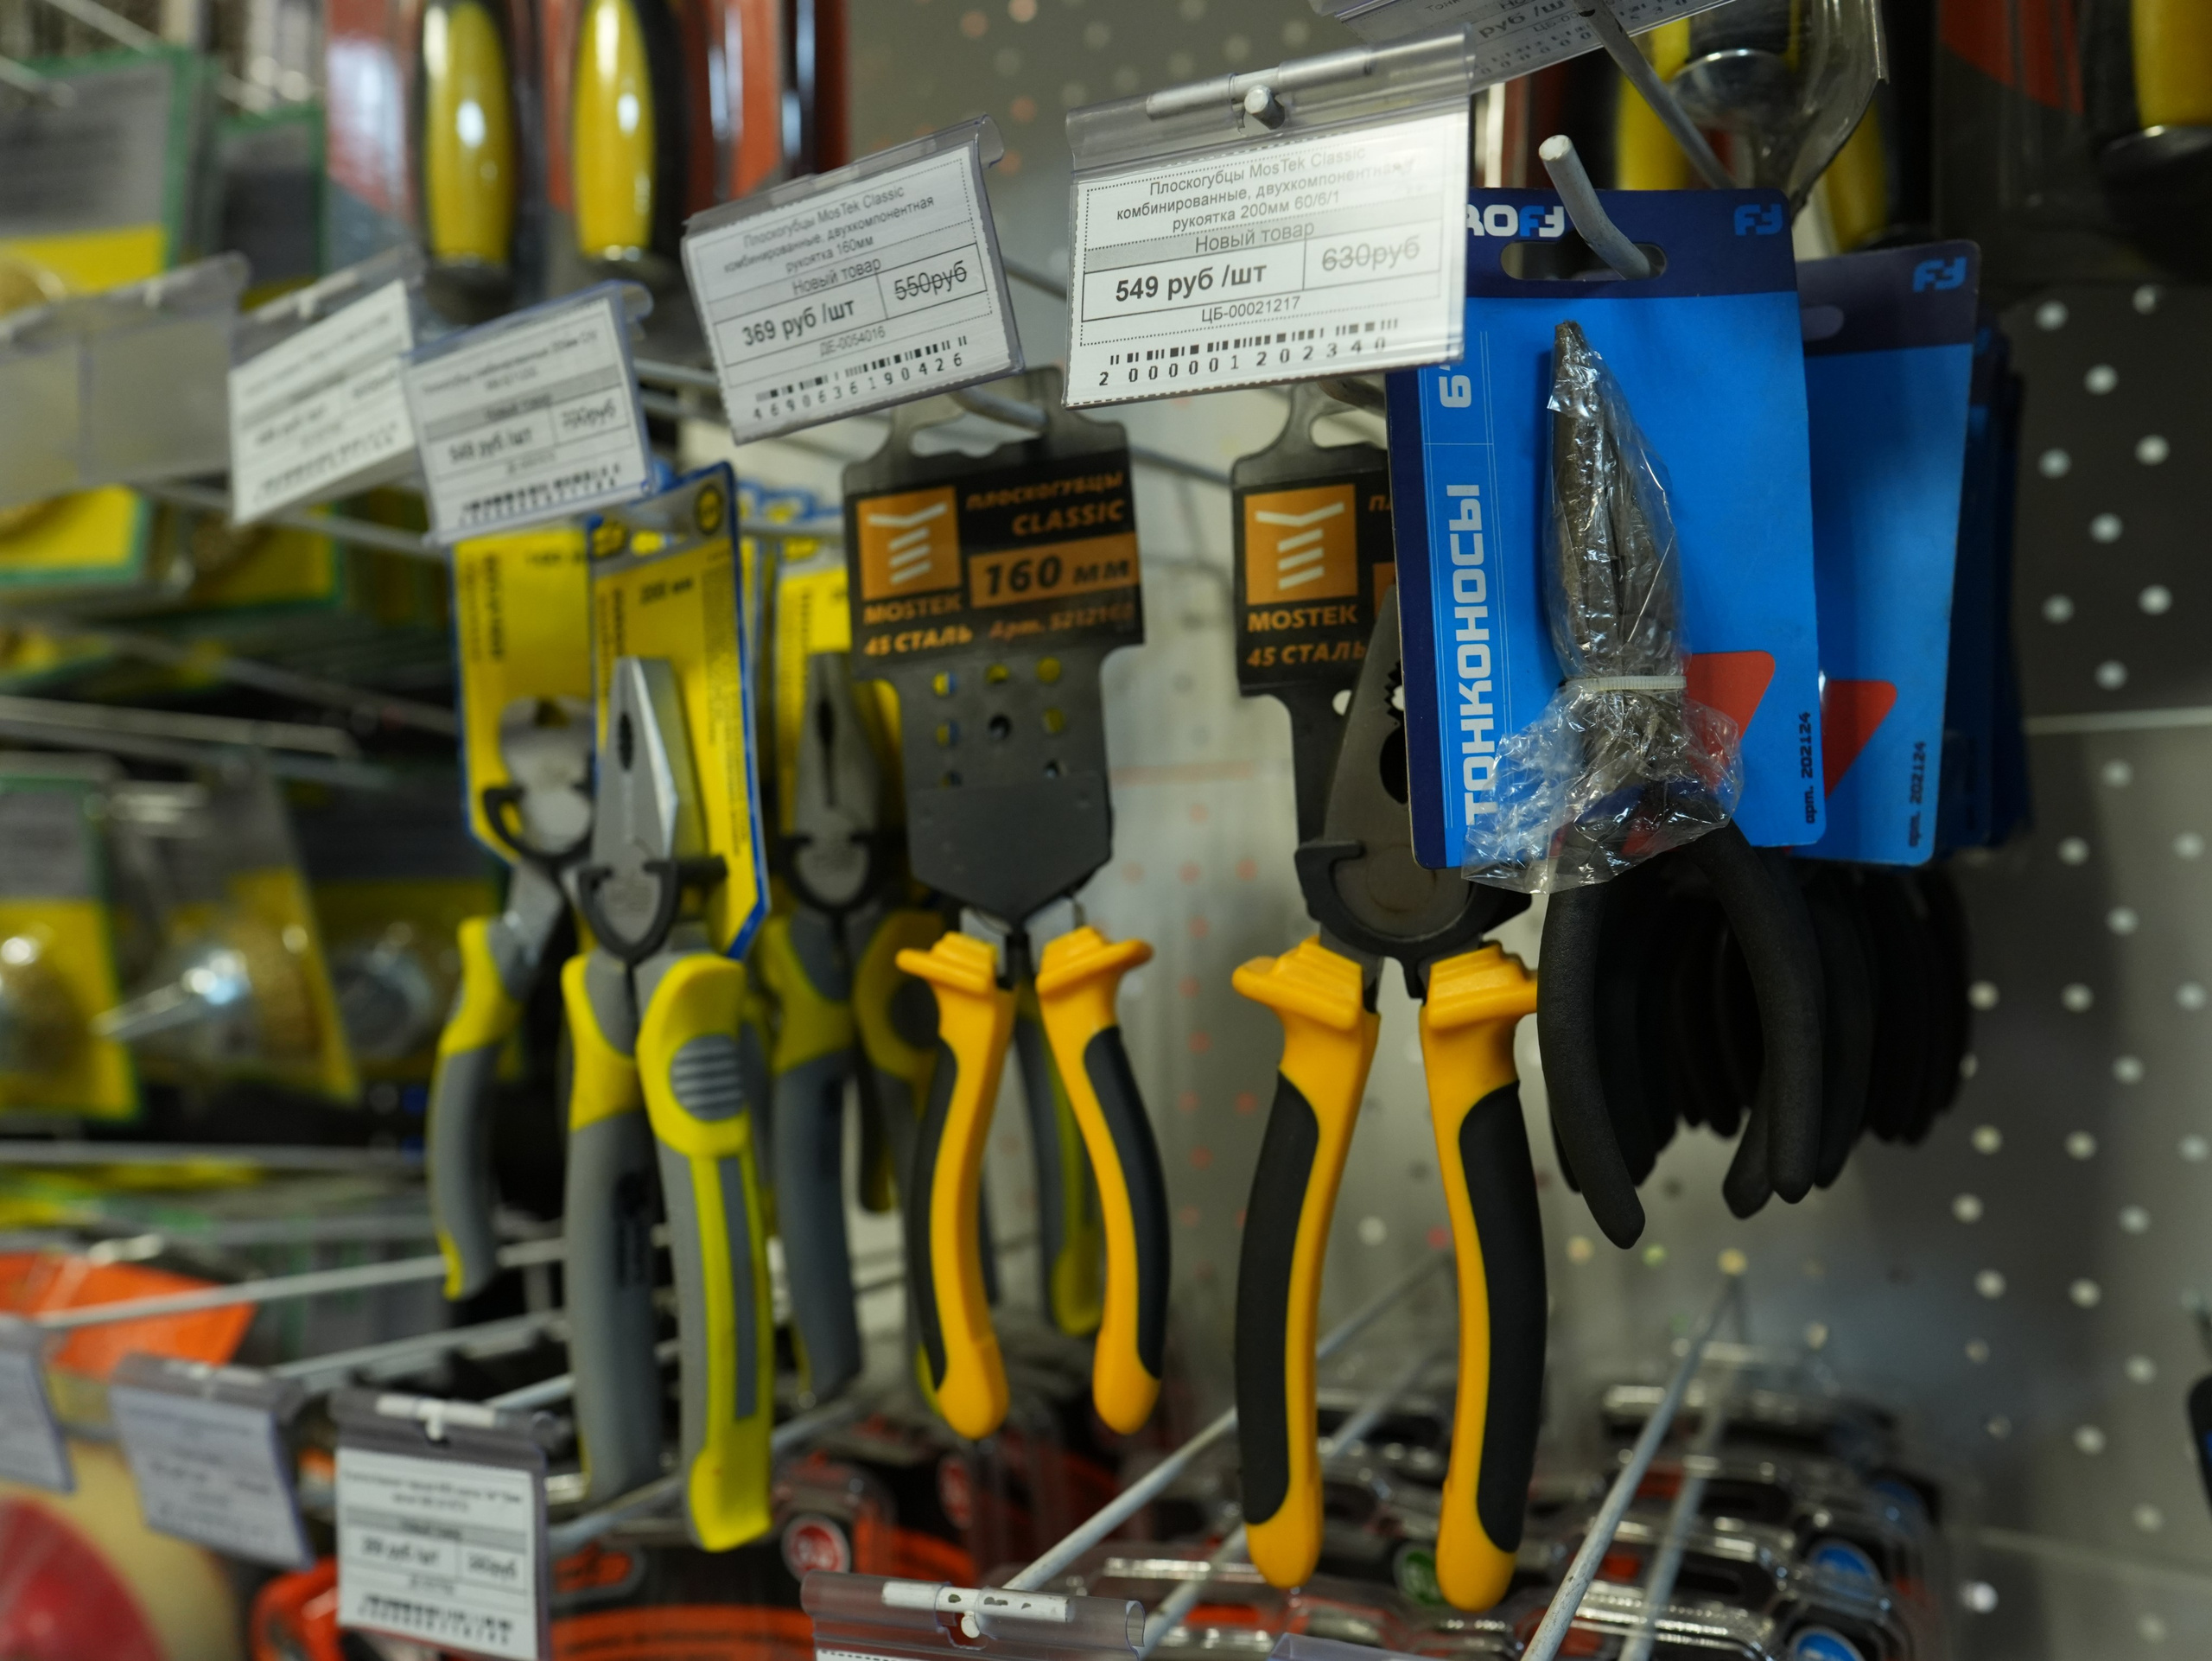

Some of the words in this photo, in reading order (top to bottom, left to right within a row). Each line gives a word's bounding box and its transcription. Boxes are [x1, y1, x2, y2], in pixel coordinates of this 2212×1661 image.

[1150, 169, 1245, 196] Плоскогубцы
[1249, 156, 1306, 179] MosTek
[1310, 147, 1367, 169] Classic
[817, 200, 861, 224] MosTek
[862, 187, 905, 209] Classic
[827, 196, 934, 242] двухкомпонентная
[1116, 188, 1251, 220] комбинированные,
[1173, 210, 1236, 233] рукоятка
[1241, 200, 1290, 220] 200мм
[1294, 190, 1339, 210] 60/6/1
[1196, 229, 1255, 253] Новый
[1261, 222, 1315, 243] товар
[1322, 234, 1421, 271] 630руб
[791, 269, 839, 296] Новый
[842, 258, 881, 281] товар
[894, 260, 967, 301] 550руб
[1116, 275, 1159, 302] 549
[1167, 266, 1214, 301] руб
[1221, 264, 1268, 288] /шт
[742, 320, 777, 347] 369
[782, 306, 817, 340] руб
[822, 299, 855, 323] /шт
[1201, 296, 1301, 324] ЦБ-00021217
[1011, 499, 1125, 537] CLASSIC
[984, 555, 1063, 598] 160
[864, 593, 962, 626] MOSTEK
[1247, 605, 1358, 633] MOSTEK
[864, 633, 892, 656] 45
[893, 623, 974, 652] СТАЛЬ
[1247, 646, 1276, 667] 45
[1281, 640, 1369, 665] СТАЛЬ
[1447, 483, 1498, 827] ТОНКОНОСЫ
[1799, 711, 1814, 779] 202124
